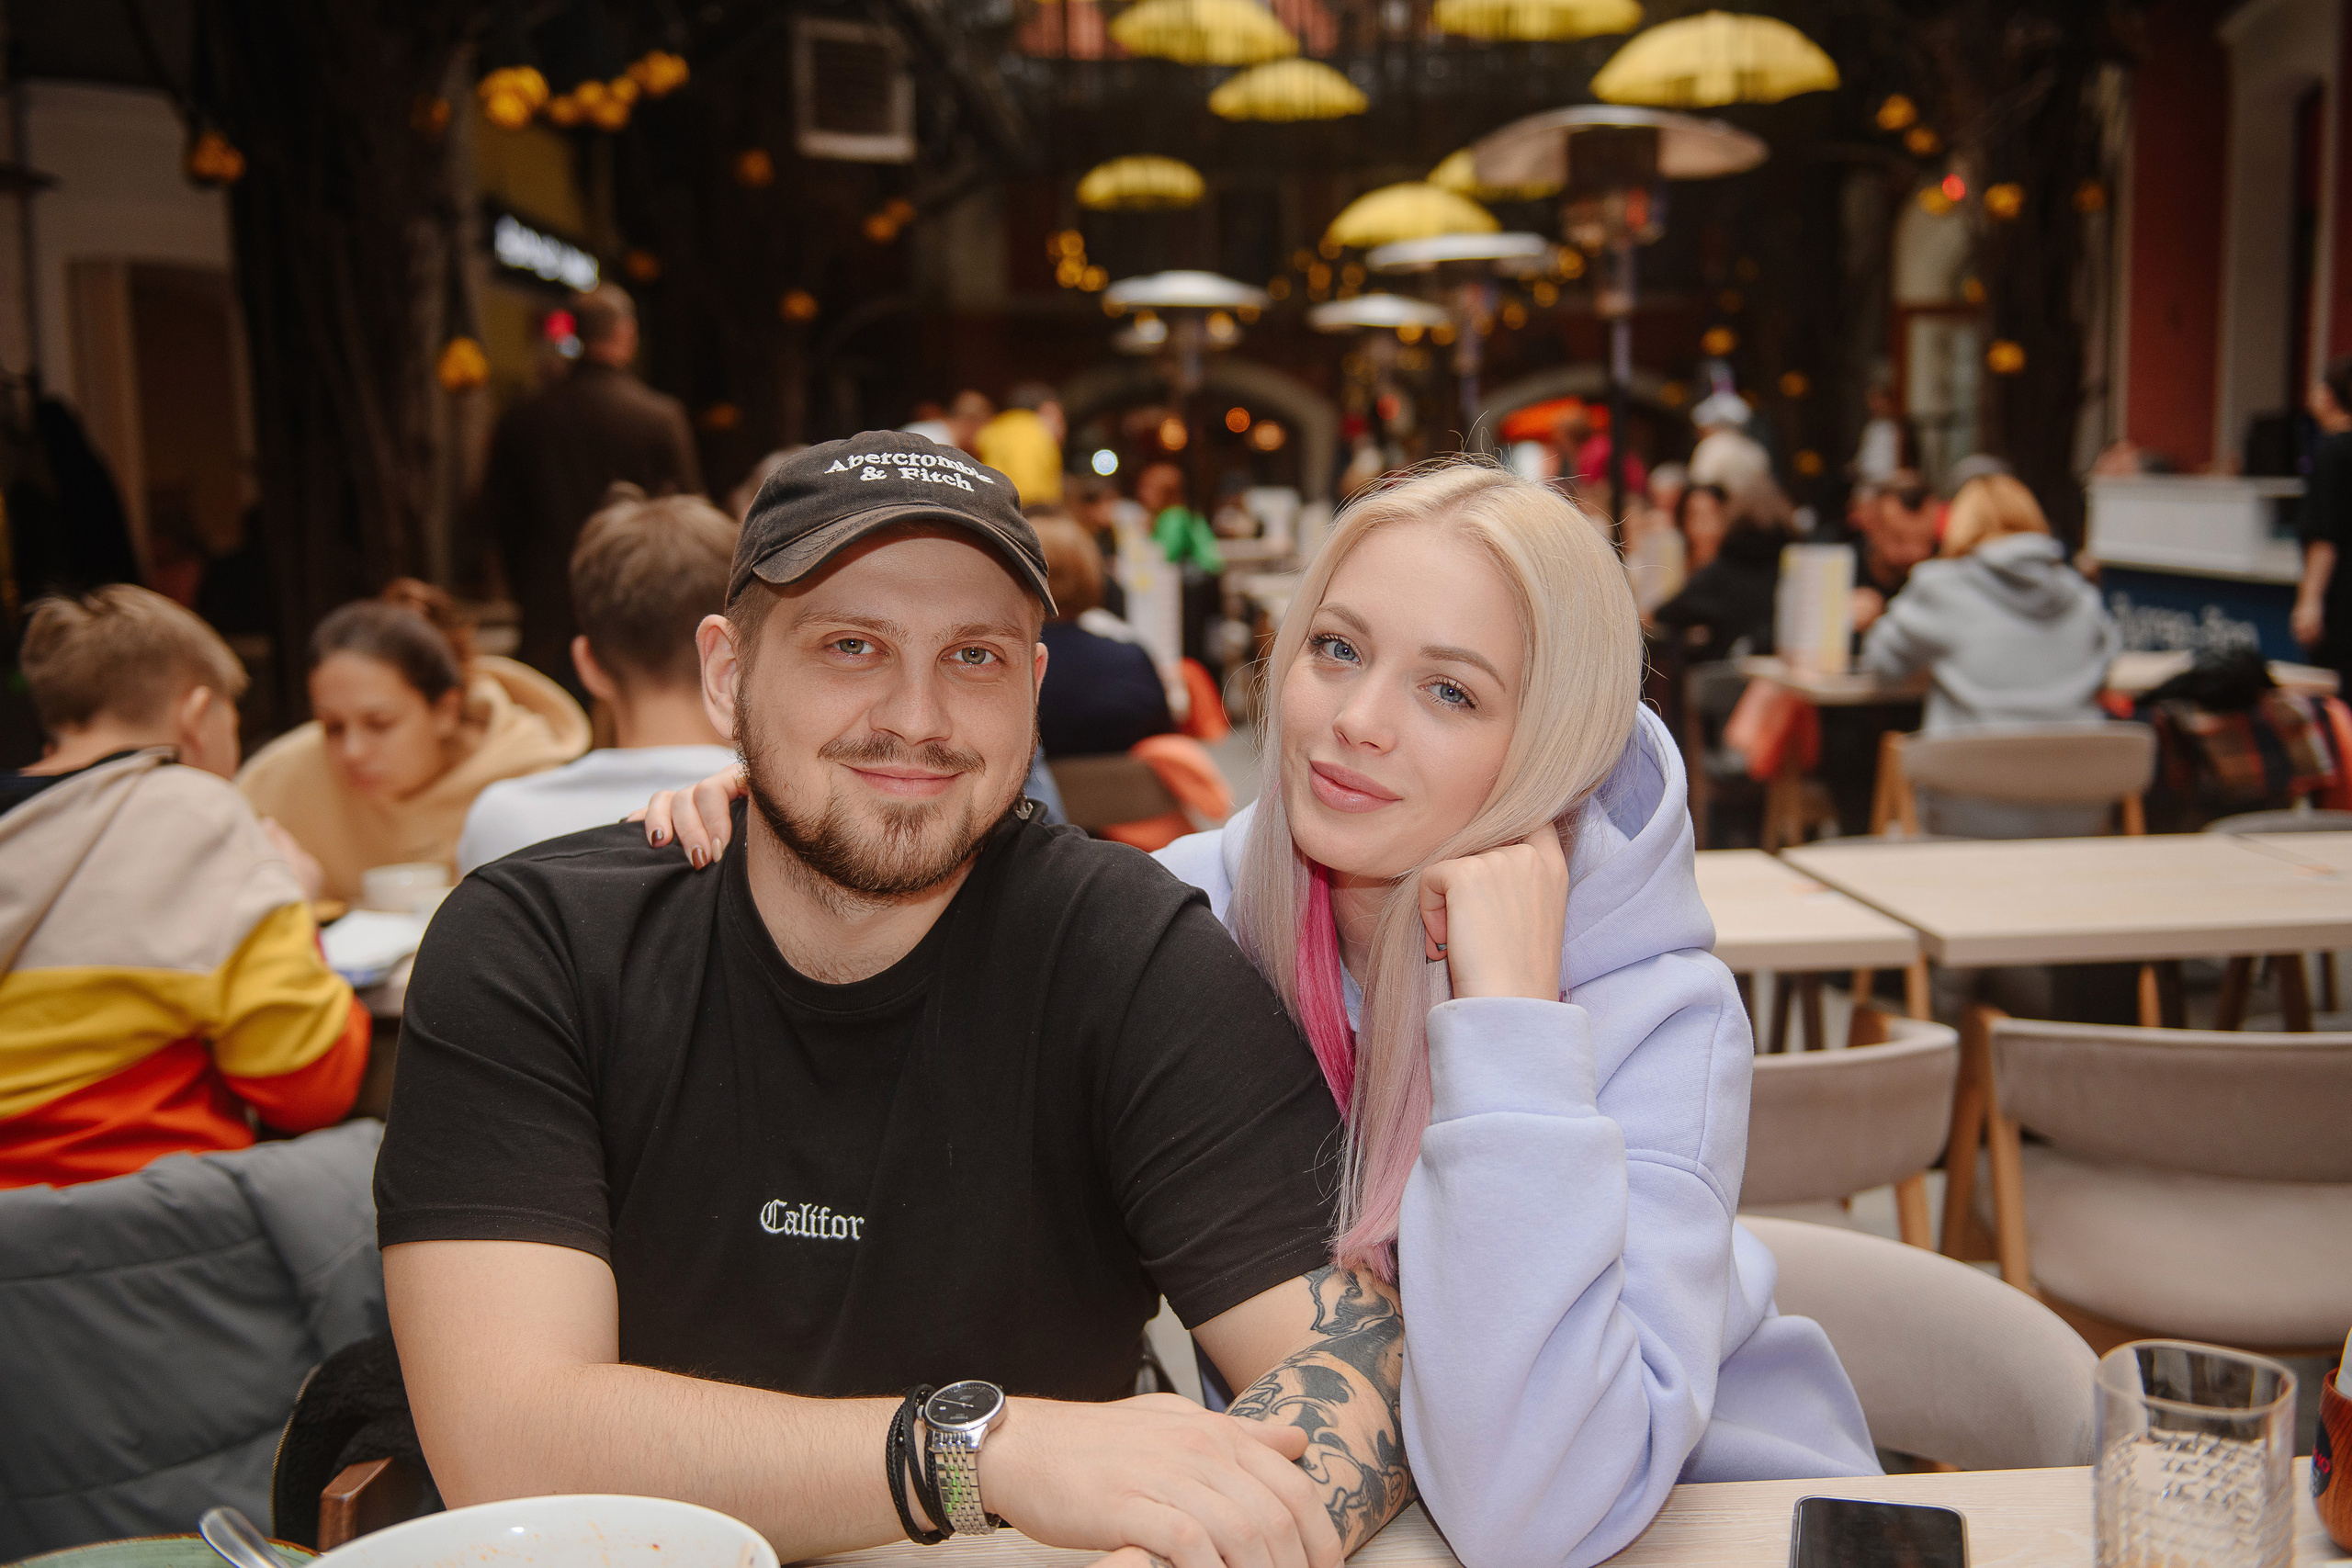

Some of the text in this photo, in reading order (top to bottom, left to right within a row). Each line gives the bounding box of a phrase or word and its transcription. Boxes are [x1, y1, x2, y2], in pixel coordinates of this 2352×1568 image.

[859, 466, 975, 492] & Fitch
[760, 1199, 865, 1241] Califor
